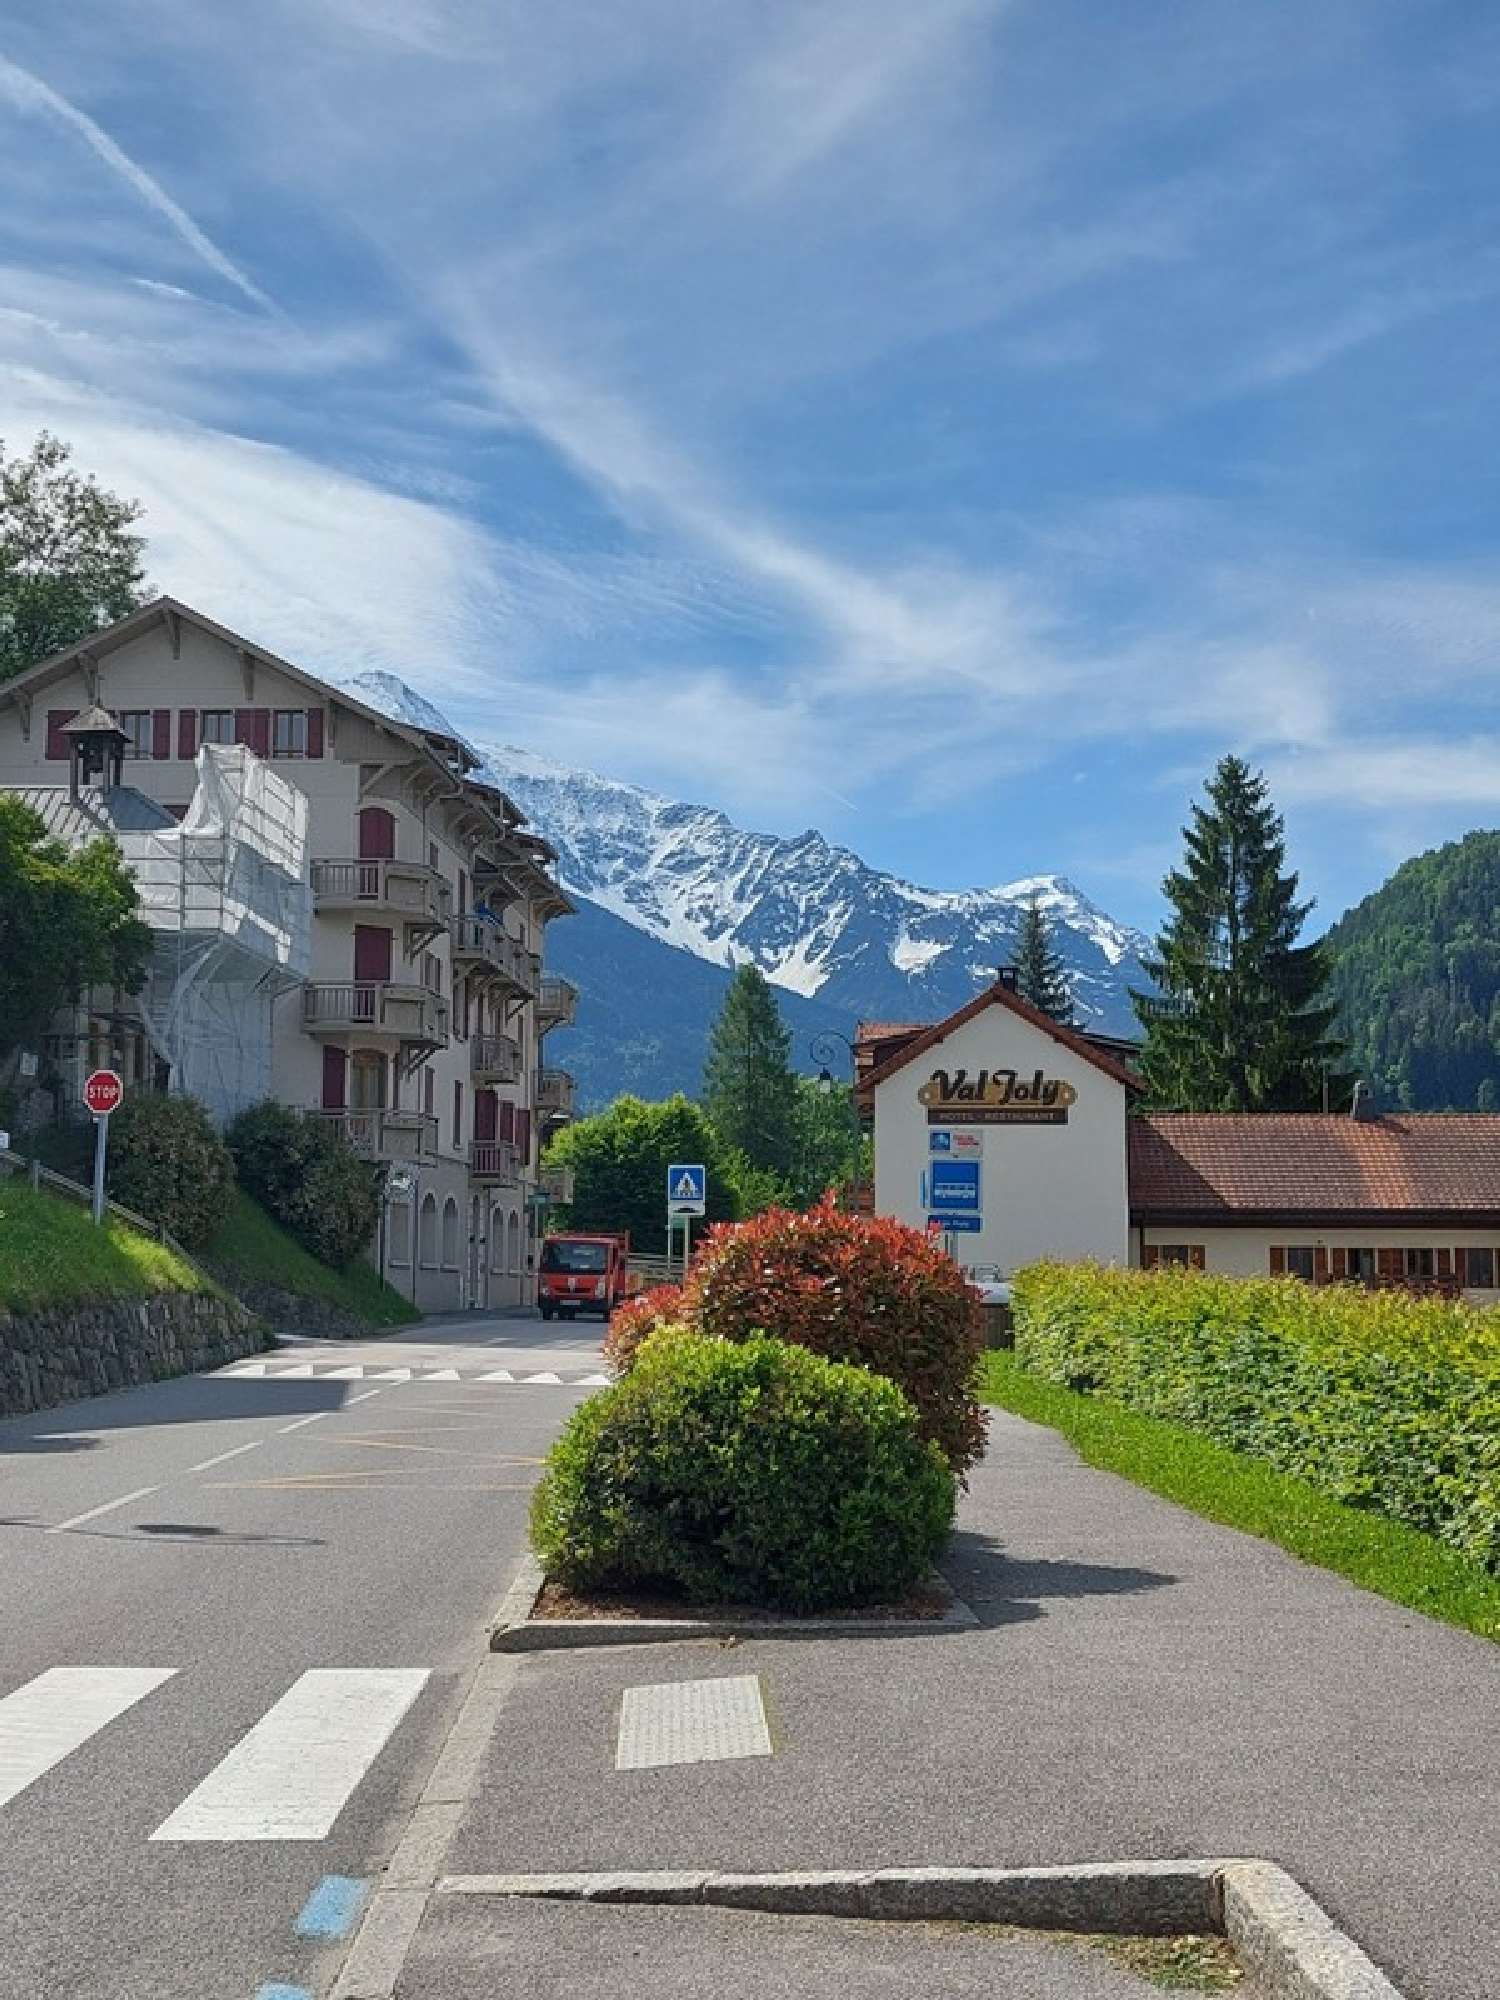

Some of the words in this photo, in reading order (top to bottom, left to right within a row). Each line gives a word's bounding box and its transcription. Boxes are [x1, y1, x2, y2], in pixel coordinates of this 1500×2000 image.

[89, 1084, 118, 1099] STOP
[930, 1069, 989, 1101] Val
[992, 1069, 1059, 1106] Joly
